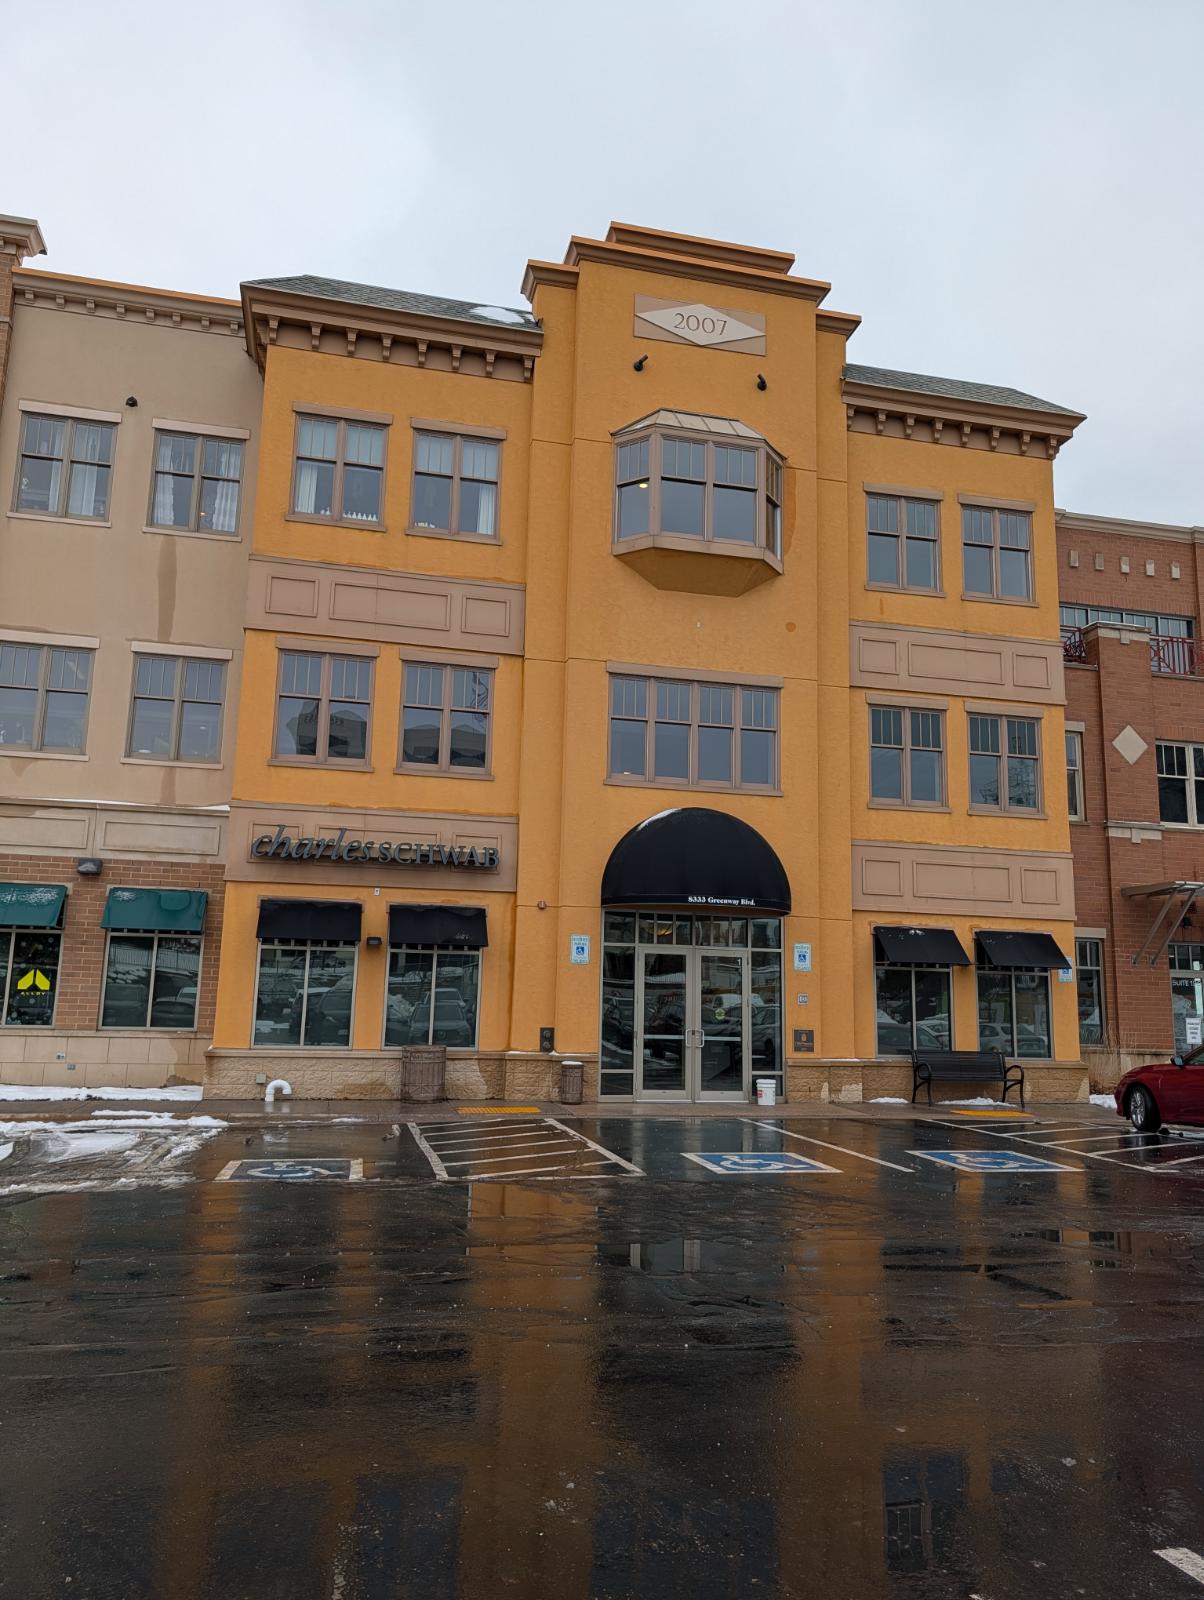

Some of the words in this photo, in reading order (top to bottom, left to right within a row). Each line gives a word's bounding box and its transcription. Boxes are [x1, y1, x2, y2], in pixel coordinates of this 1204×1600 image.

[674, 312, 728, 336] 2007
[251, 824, 375, 861] charles
[378, 841, 500, 867] SCHWAB
[708, 897, 740, 906] Greenway
